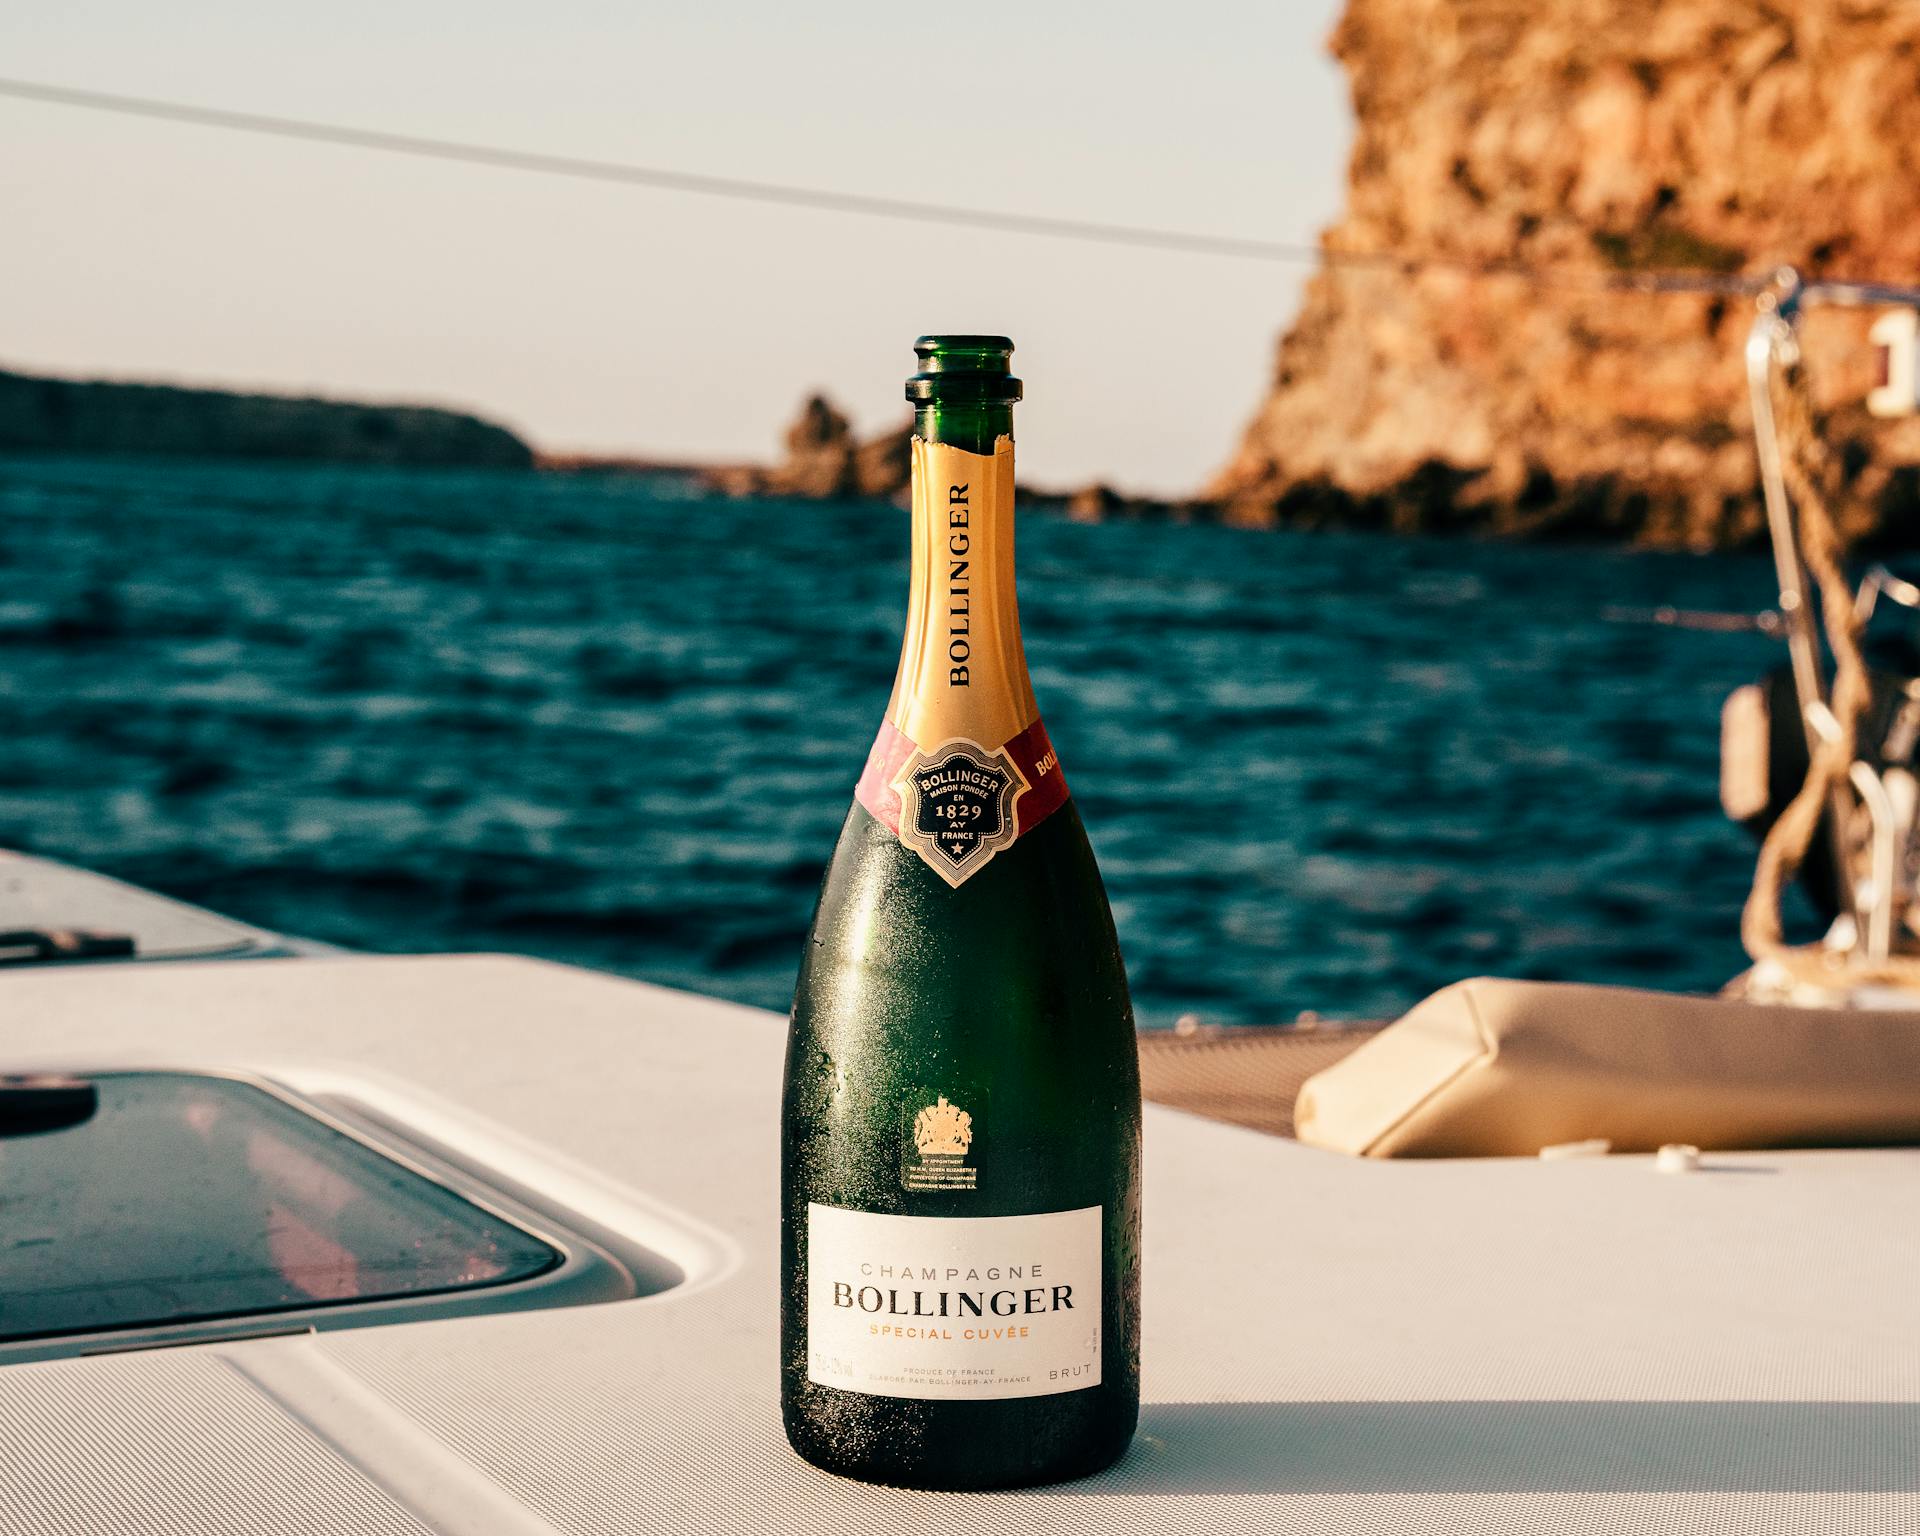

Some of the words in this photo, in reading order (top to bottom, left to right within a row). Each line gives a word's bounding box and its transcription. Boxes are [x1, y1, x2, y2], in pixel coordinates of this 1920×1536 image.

[949, 482, 970, 688] BOLLINGER
[921, 769, 999, 792] BOLLINGER
[930, 784, 958, 799] MAISON
[960, 784, 989, 800] FONDÉE
[953, 794, 964, 802] EN
[935, 804, 982, 820] 1829
[949, 821, 966, 829] AY
[942, 831, 974, 840] FRANCE
[860, 1262, 1043, 1281] CHAMPAGNE
[832, 1281, 1076, 1318] BOLLINGER
[869, 1324, 952, 1340] SPECIAL
[964, 1325, 1030, 1341] CUVÉE
[903, 1367, 943, 1376] PRODUCE
[946, 1369, 957, 1377] OF
[961, 1368, 996, 1376] FRANCE
[1049, 1364, 1091, 1381] BRUT
